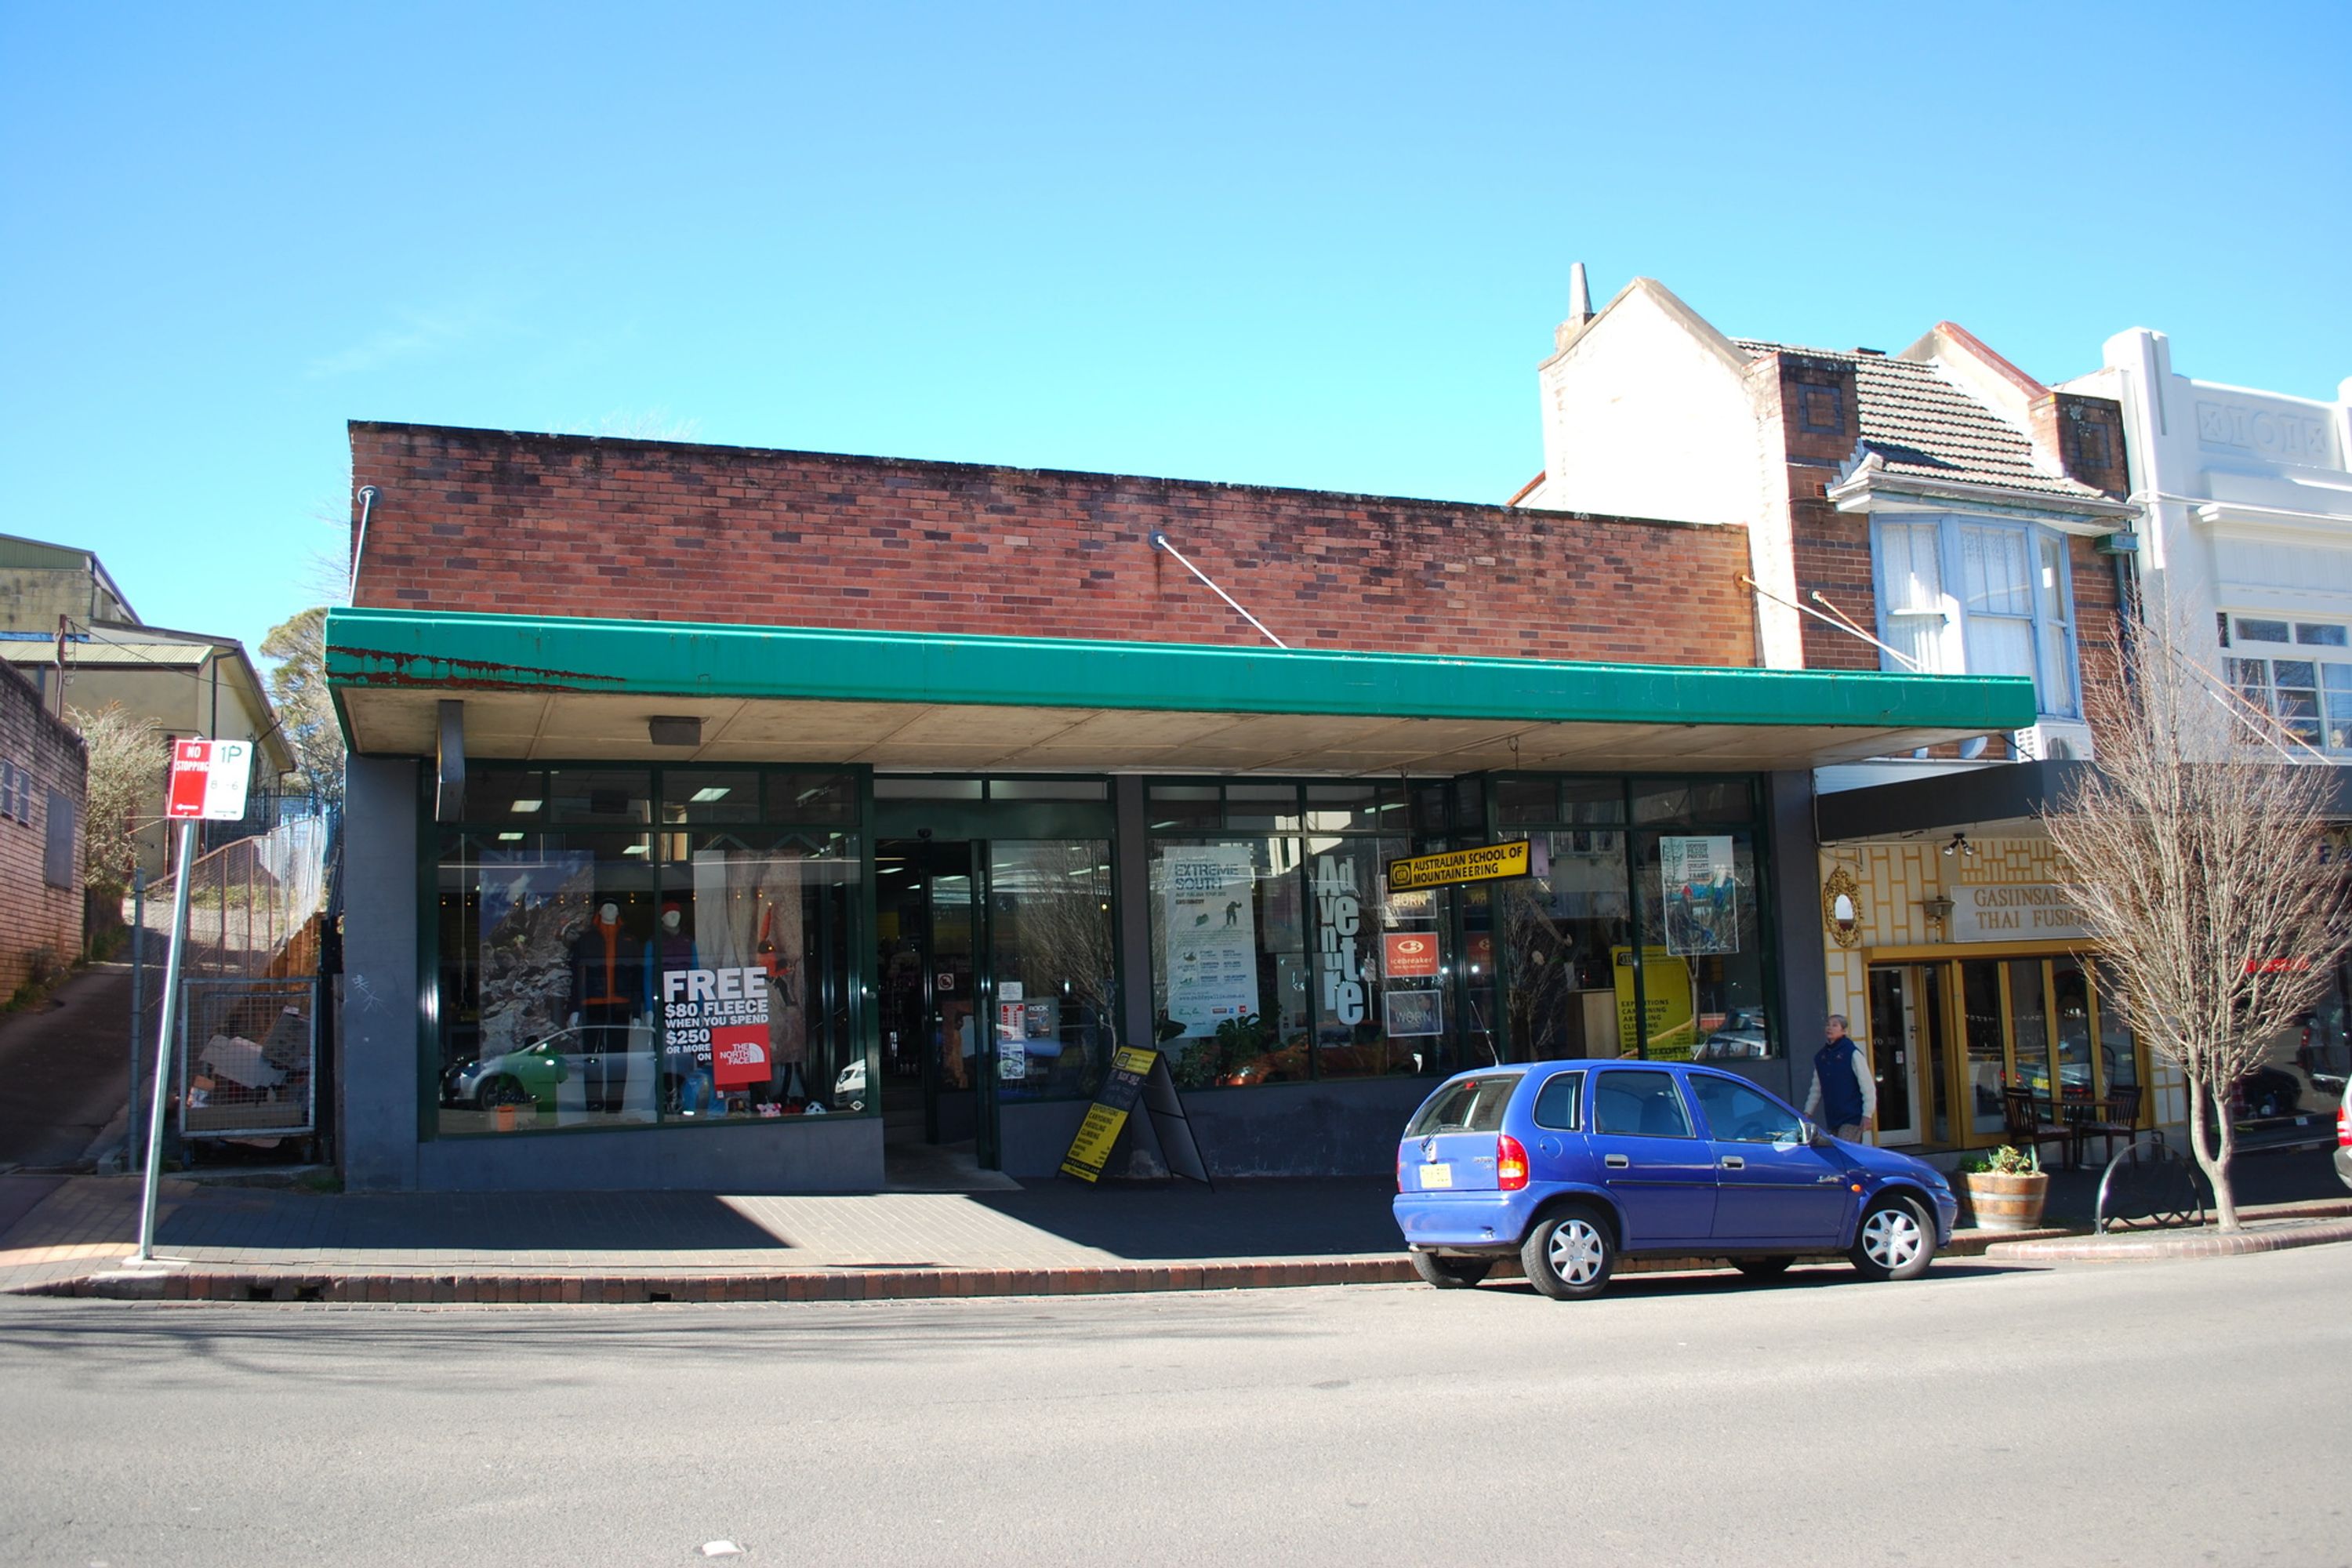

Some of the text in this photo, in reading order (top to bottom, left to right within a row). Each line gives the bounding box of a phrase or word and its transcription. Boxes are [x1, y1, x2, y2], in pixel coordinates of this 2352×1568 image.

[187, 746, 201, 758] NO
[221, 746, 242, 764] 1P
[176, 760, 209, 772] STOPPING
[1414, 846, 1523, 872] AUSTRALIAN SCHOOL OF
[1175, 863, 1239, 877] EXTREME
[1413, 863, 1498, 884] MOUNTAINEERING
[1176, 877, 1222, 890] SOUTH
[1392, 894, 1426, 906] BORN
[1976, 911, 2020, 929] THAI
[1390, 956, 1433, 965] icebreaker
[663, 967, 768, 1003] FREE
[665, 1000, 768, 1018] $80 FLEECE
[666, 1014, 769, 1028] WHEN YOU SPEND
[666, 1029, 710, 1045] $250
[667, 1044, 711, 1054] OR MORE
[732, 1043, 750, 1051] THE
[720, 1050, 750, 1059] NORTH
[727, 1057, 750, 1065] FACE
